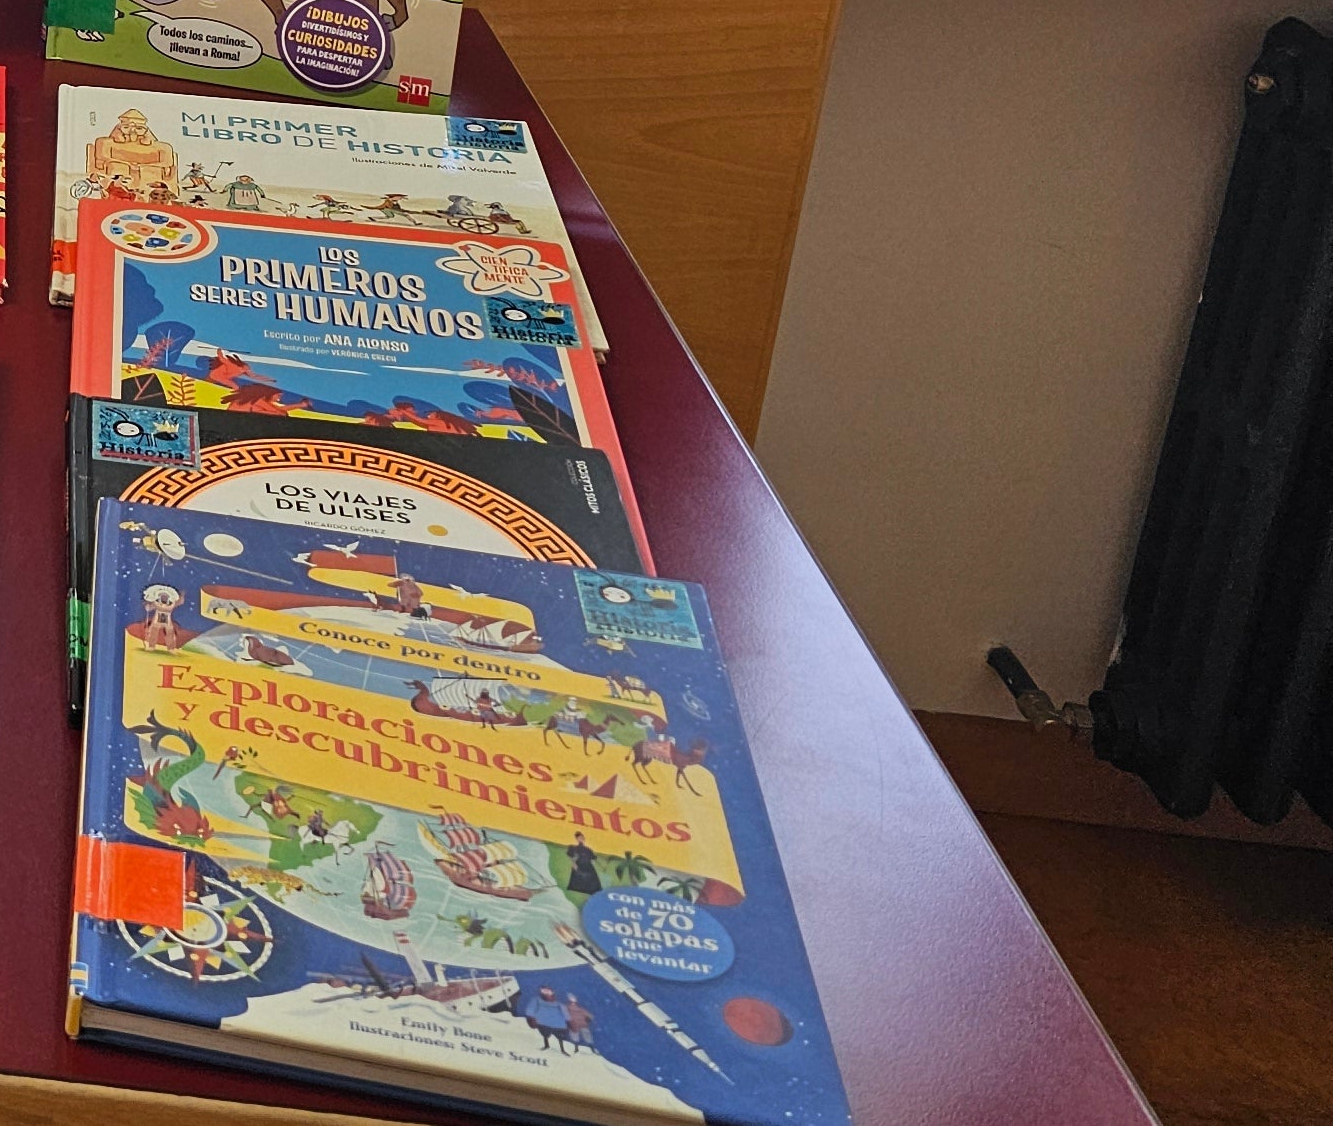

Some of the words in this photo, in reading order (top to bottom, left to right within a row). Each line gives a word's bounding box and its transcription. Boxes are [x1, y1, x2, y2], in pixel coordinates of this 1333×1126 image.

[306, 6, 369, 31] ¡DIBUJOS
[159, 25, 187, 40] Todos
[189, 30, 204, 42] los
[287, 29, 378, 59] CURIOSIDADES
[169, 42, 201, 56] ¡llevan
[202, 49, 209, 57] a
[211, 47, 240, 61] Roma!
[182, 112, 216, 125] MI
[228, 115, 358, 138] PRIMER
[182, 126, 282, 144] LIBRO
[293, 135, 337, 150] DE
[347, 140, 513, 165] HISTORIA
[319, 246, 360, 266] LOS
[220, 255, 428, 302] PRIMEROS
[190, 283, 268, 309] SERES
[275, 291, 485, 341] HUMANOS
[265, 482, 327, 499] LOS
[331, 489, 417, 511] VIAJES
[275, 498, 314, 515] DE
[320, 503, 412, 525] ULISES
[298, 620, 392, 651] Conoce
[400, 645, 447, 668] por
[455, 653, 542, 682] dentro
[156, 662, 553, 785] Exploraciones
[174, 700, 198, 721] y
[208, 694, 692, 843] descubrimientos
[400, 1016, 448, 1035] Emily
[453, 1023, 492, 1042] Bone
